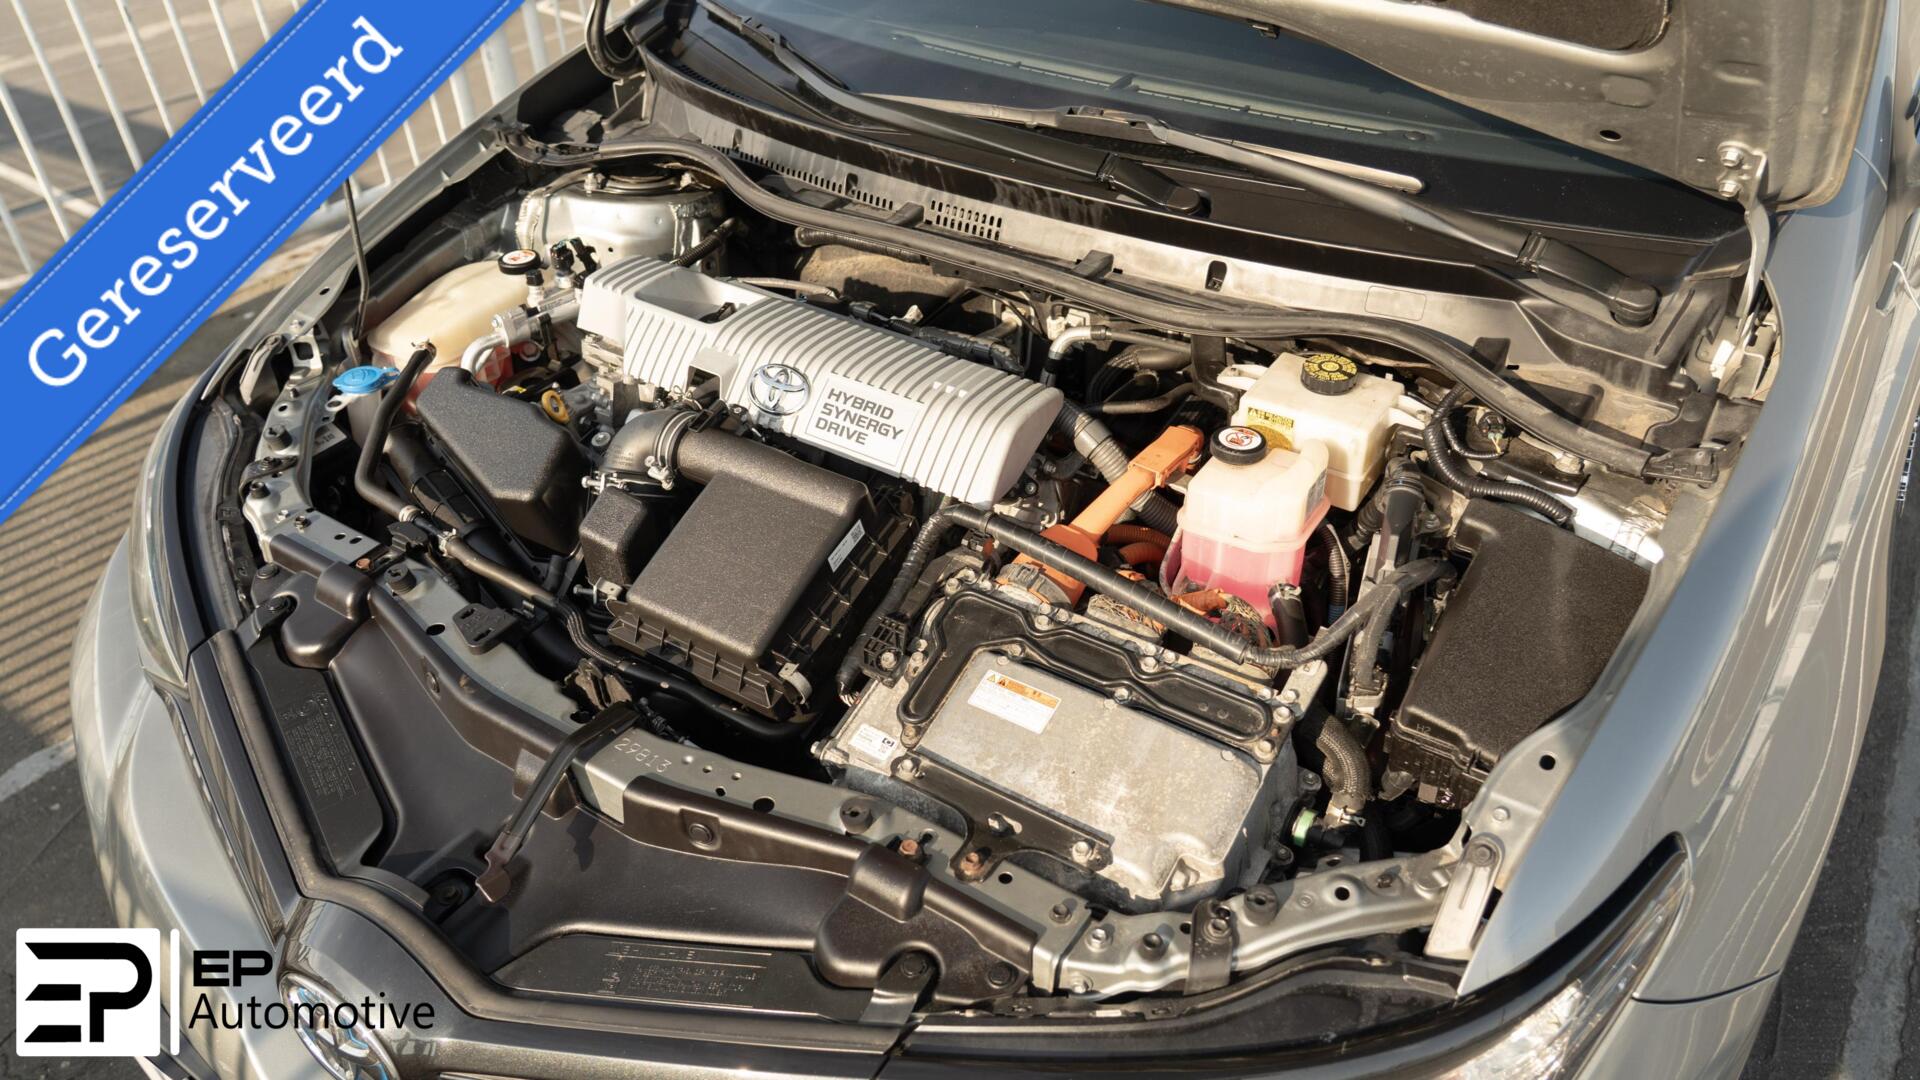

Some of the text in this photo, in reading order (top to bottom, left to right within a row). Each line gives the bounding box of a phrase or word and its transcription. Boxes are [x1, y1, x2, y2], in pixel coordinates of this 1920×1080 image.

[821, 402, 904, 440] SYNERGY
[828, 388, 893, 420] HYBRID
[815, 417, 868, 445] DRIVE
[614, 737, 672, 773] 29813
